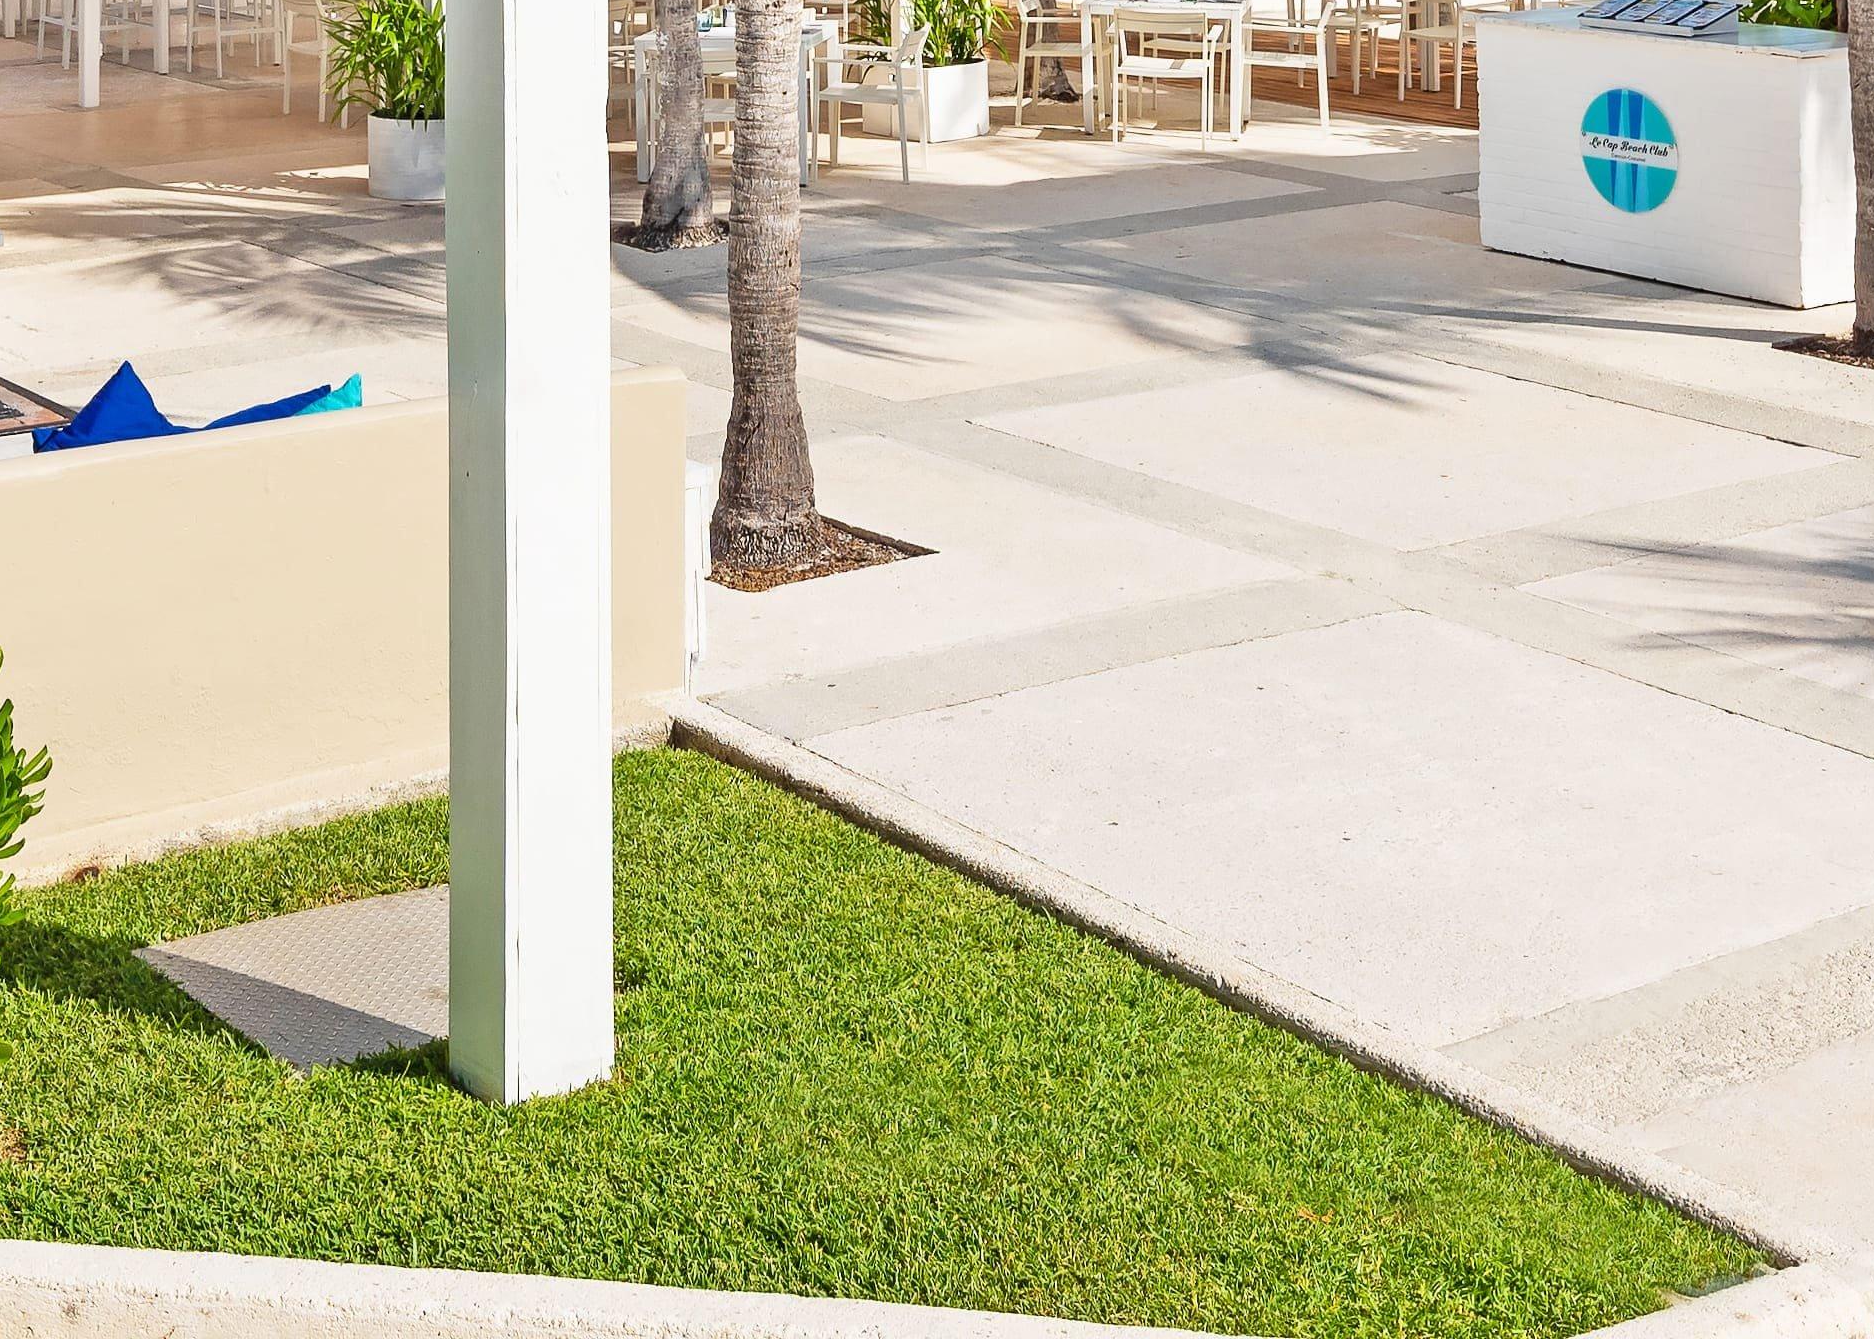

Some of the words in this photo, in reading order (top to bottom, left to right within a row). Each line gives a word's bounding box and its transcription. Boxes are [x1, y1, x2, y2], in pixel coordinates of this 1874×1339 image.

[1589, 136, 1602, 149] Le
[1603, 138, 1618, 152] Cap
[1620, 140, 1647, 154] Beach
[1649, 143, 1668, 157] Club
